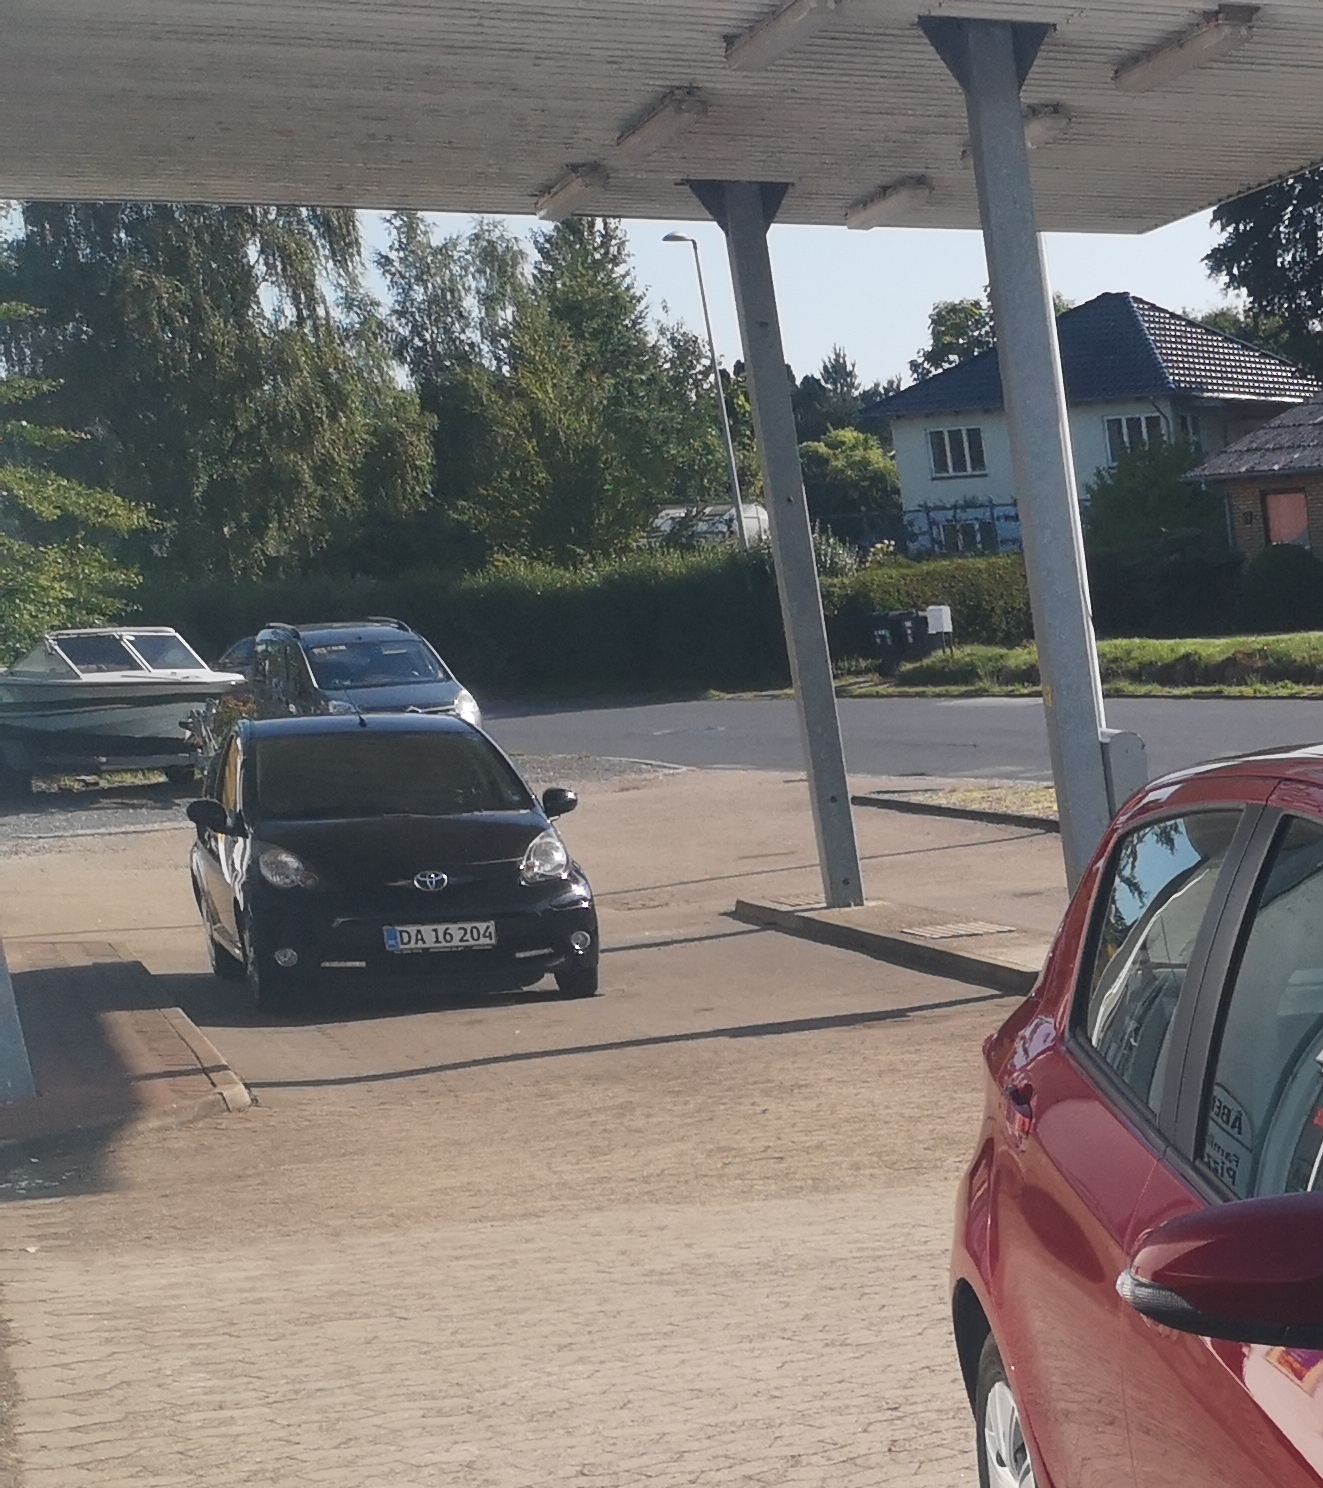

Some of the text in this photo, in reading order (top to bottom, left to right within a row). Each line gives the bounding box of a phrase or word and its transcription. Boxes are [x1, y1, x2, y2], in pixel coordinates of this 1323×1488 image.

[400, 929, 426, 946] DA
[431, 927, 454, 944] 16
[457, 925, 493, 943] 204
